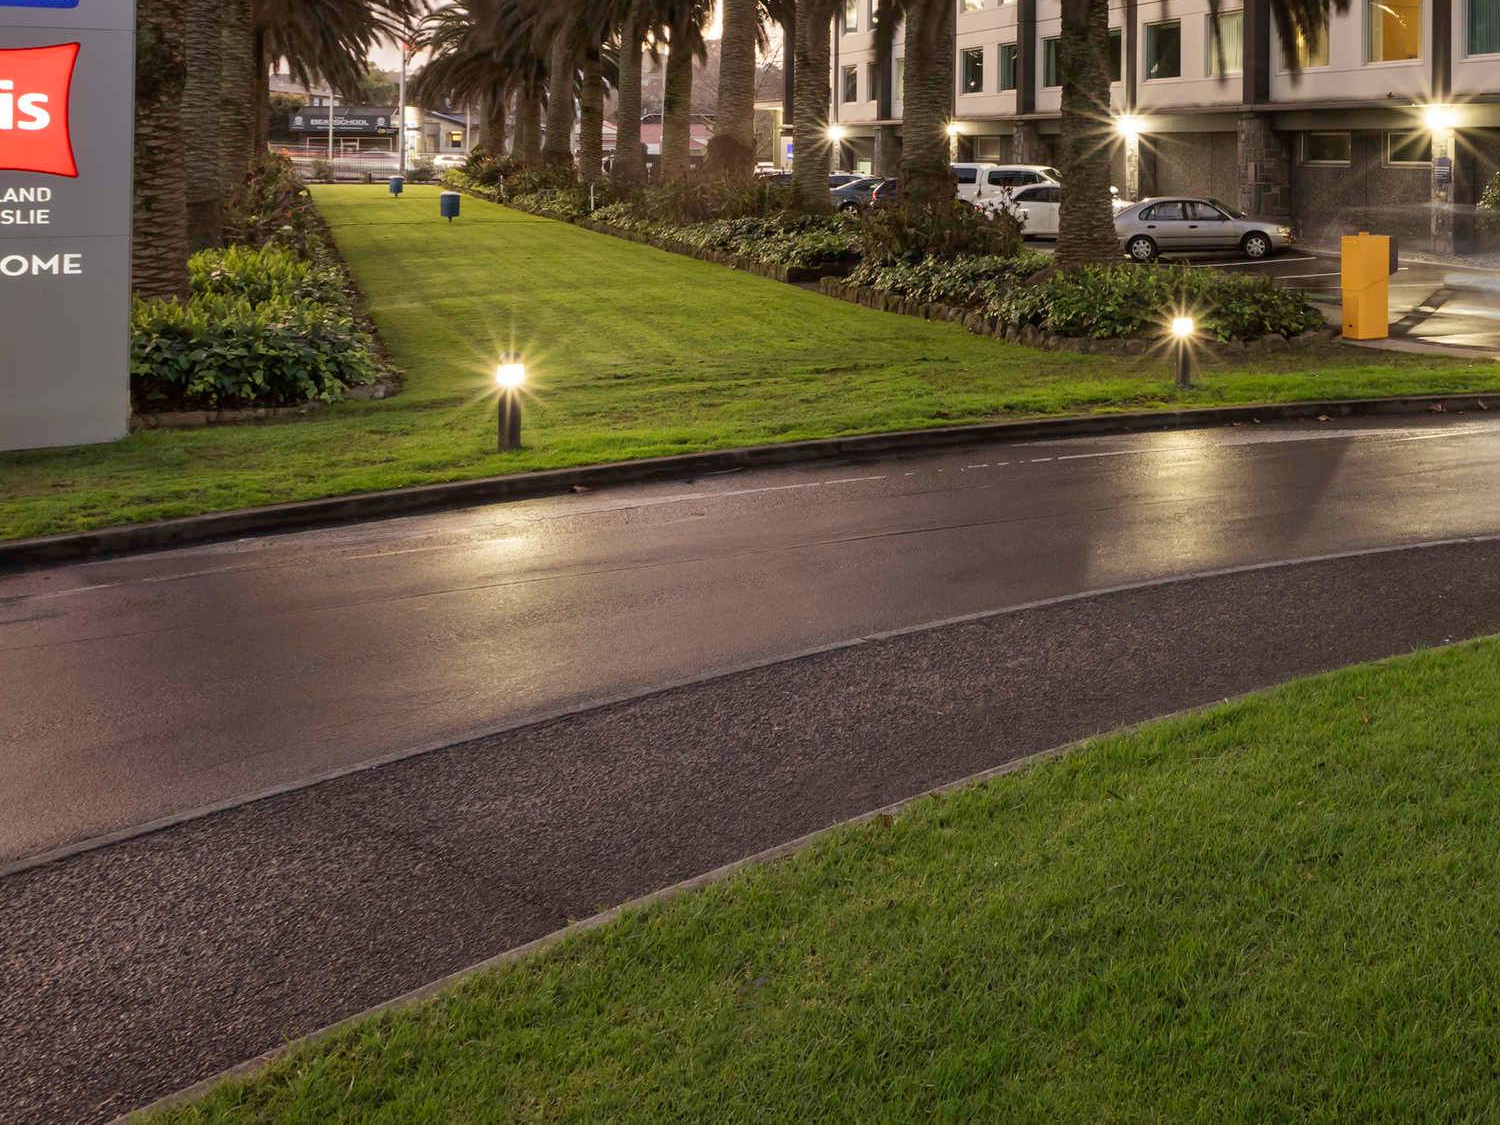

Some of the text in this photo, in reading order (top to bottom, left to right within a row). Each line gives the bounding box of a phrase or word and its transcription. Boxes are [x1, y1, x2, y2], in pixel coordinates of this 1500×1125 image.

[0, 187, 52, 202] AND
[0, 209, 50, 225] SLIE
[0, 254, 82, 276] OME
